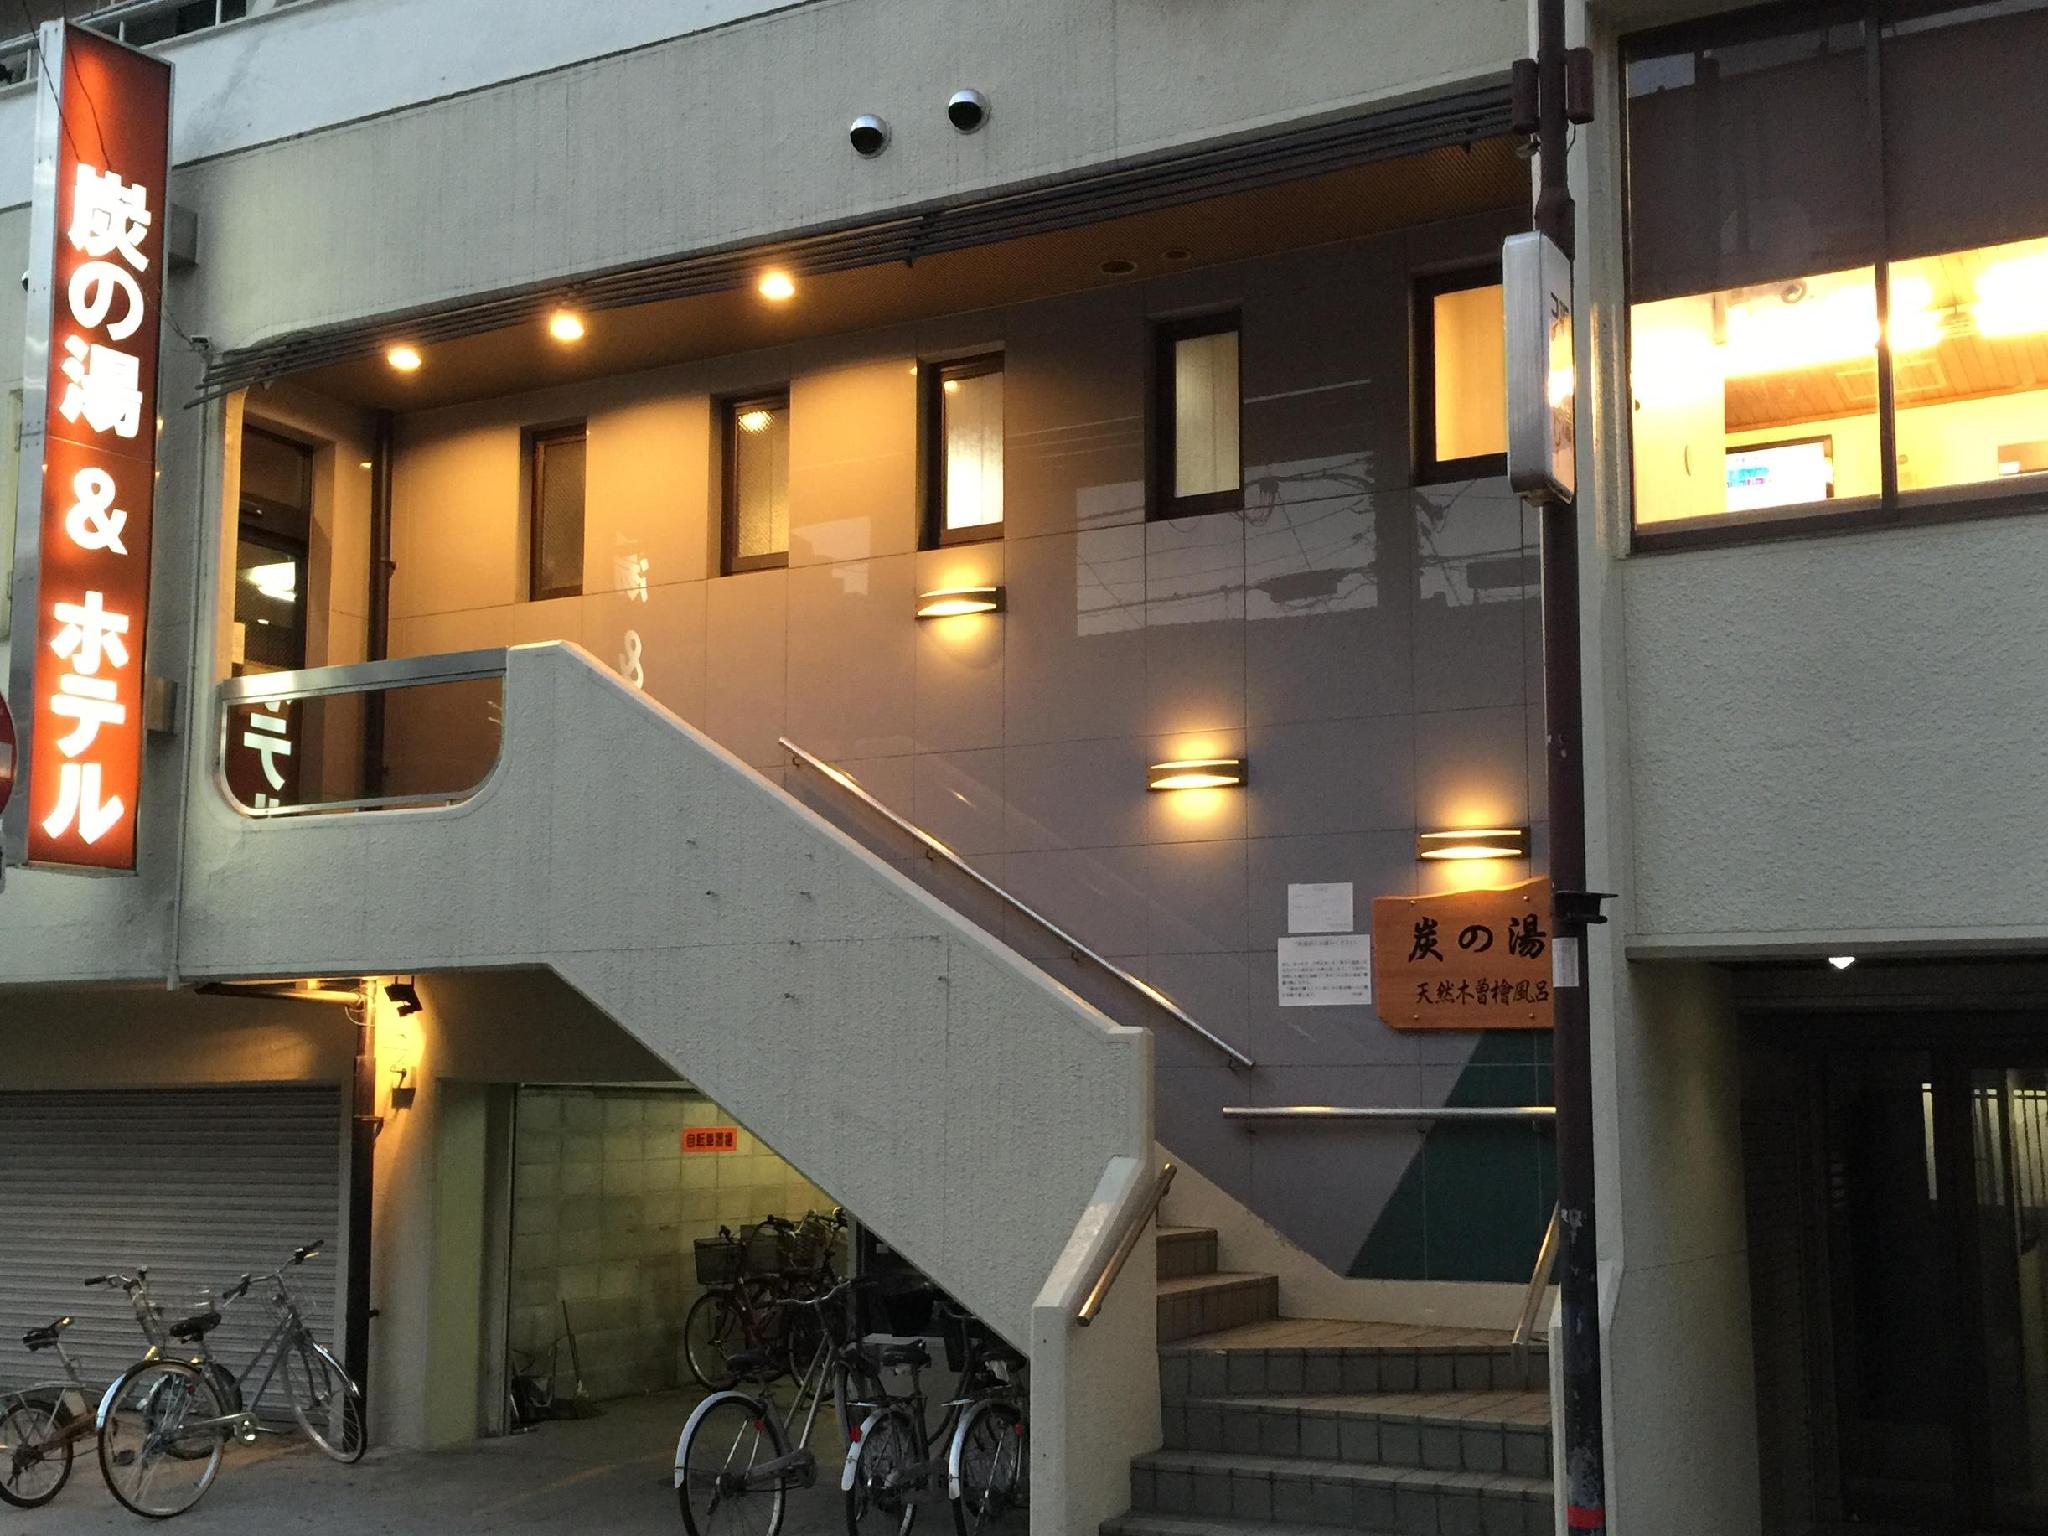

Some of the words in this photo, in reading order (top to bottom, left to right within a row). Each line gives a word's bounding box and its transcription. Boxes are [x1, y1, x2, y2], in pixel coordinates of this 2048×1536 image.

[65, 467, 128, 555] &
[42, 591, 130, 845] ホテル
[1408, 913, 1547, 962] 炭の湯
